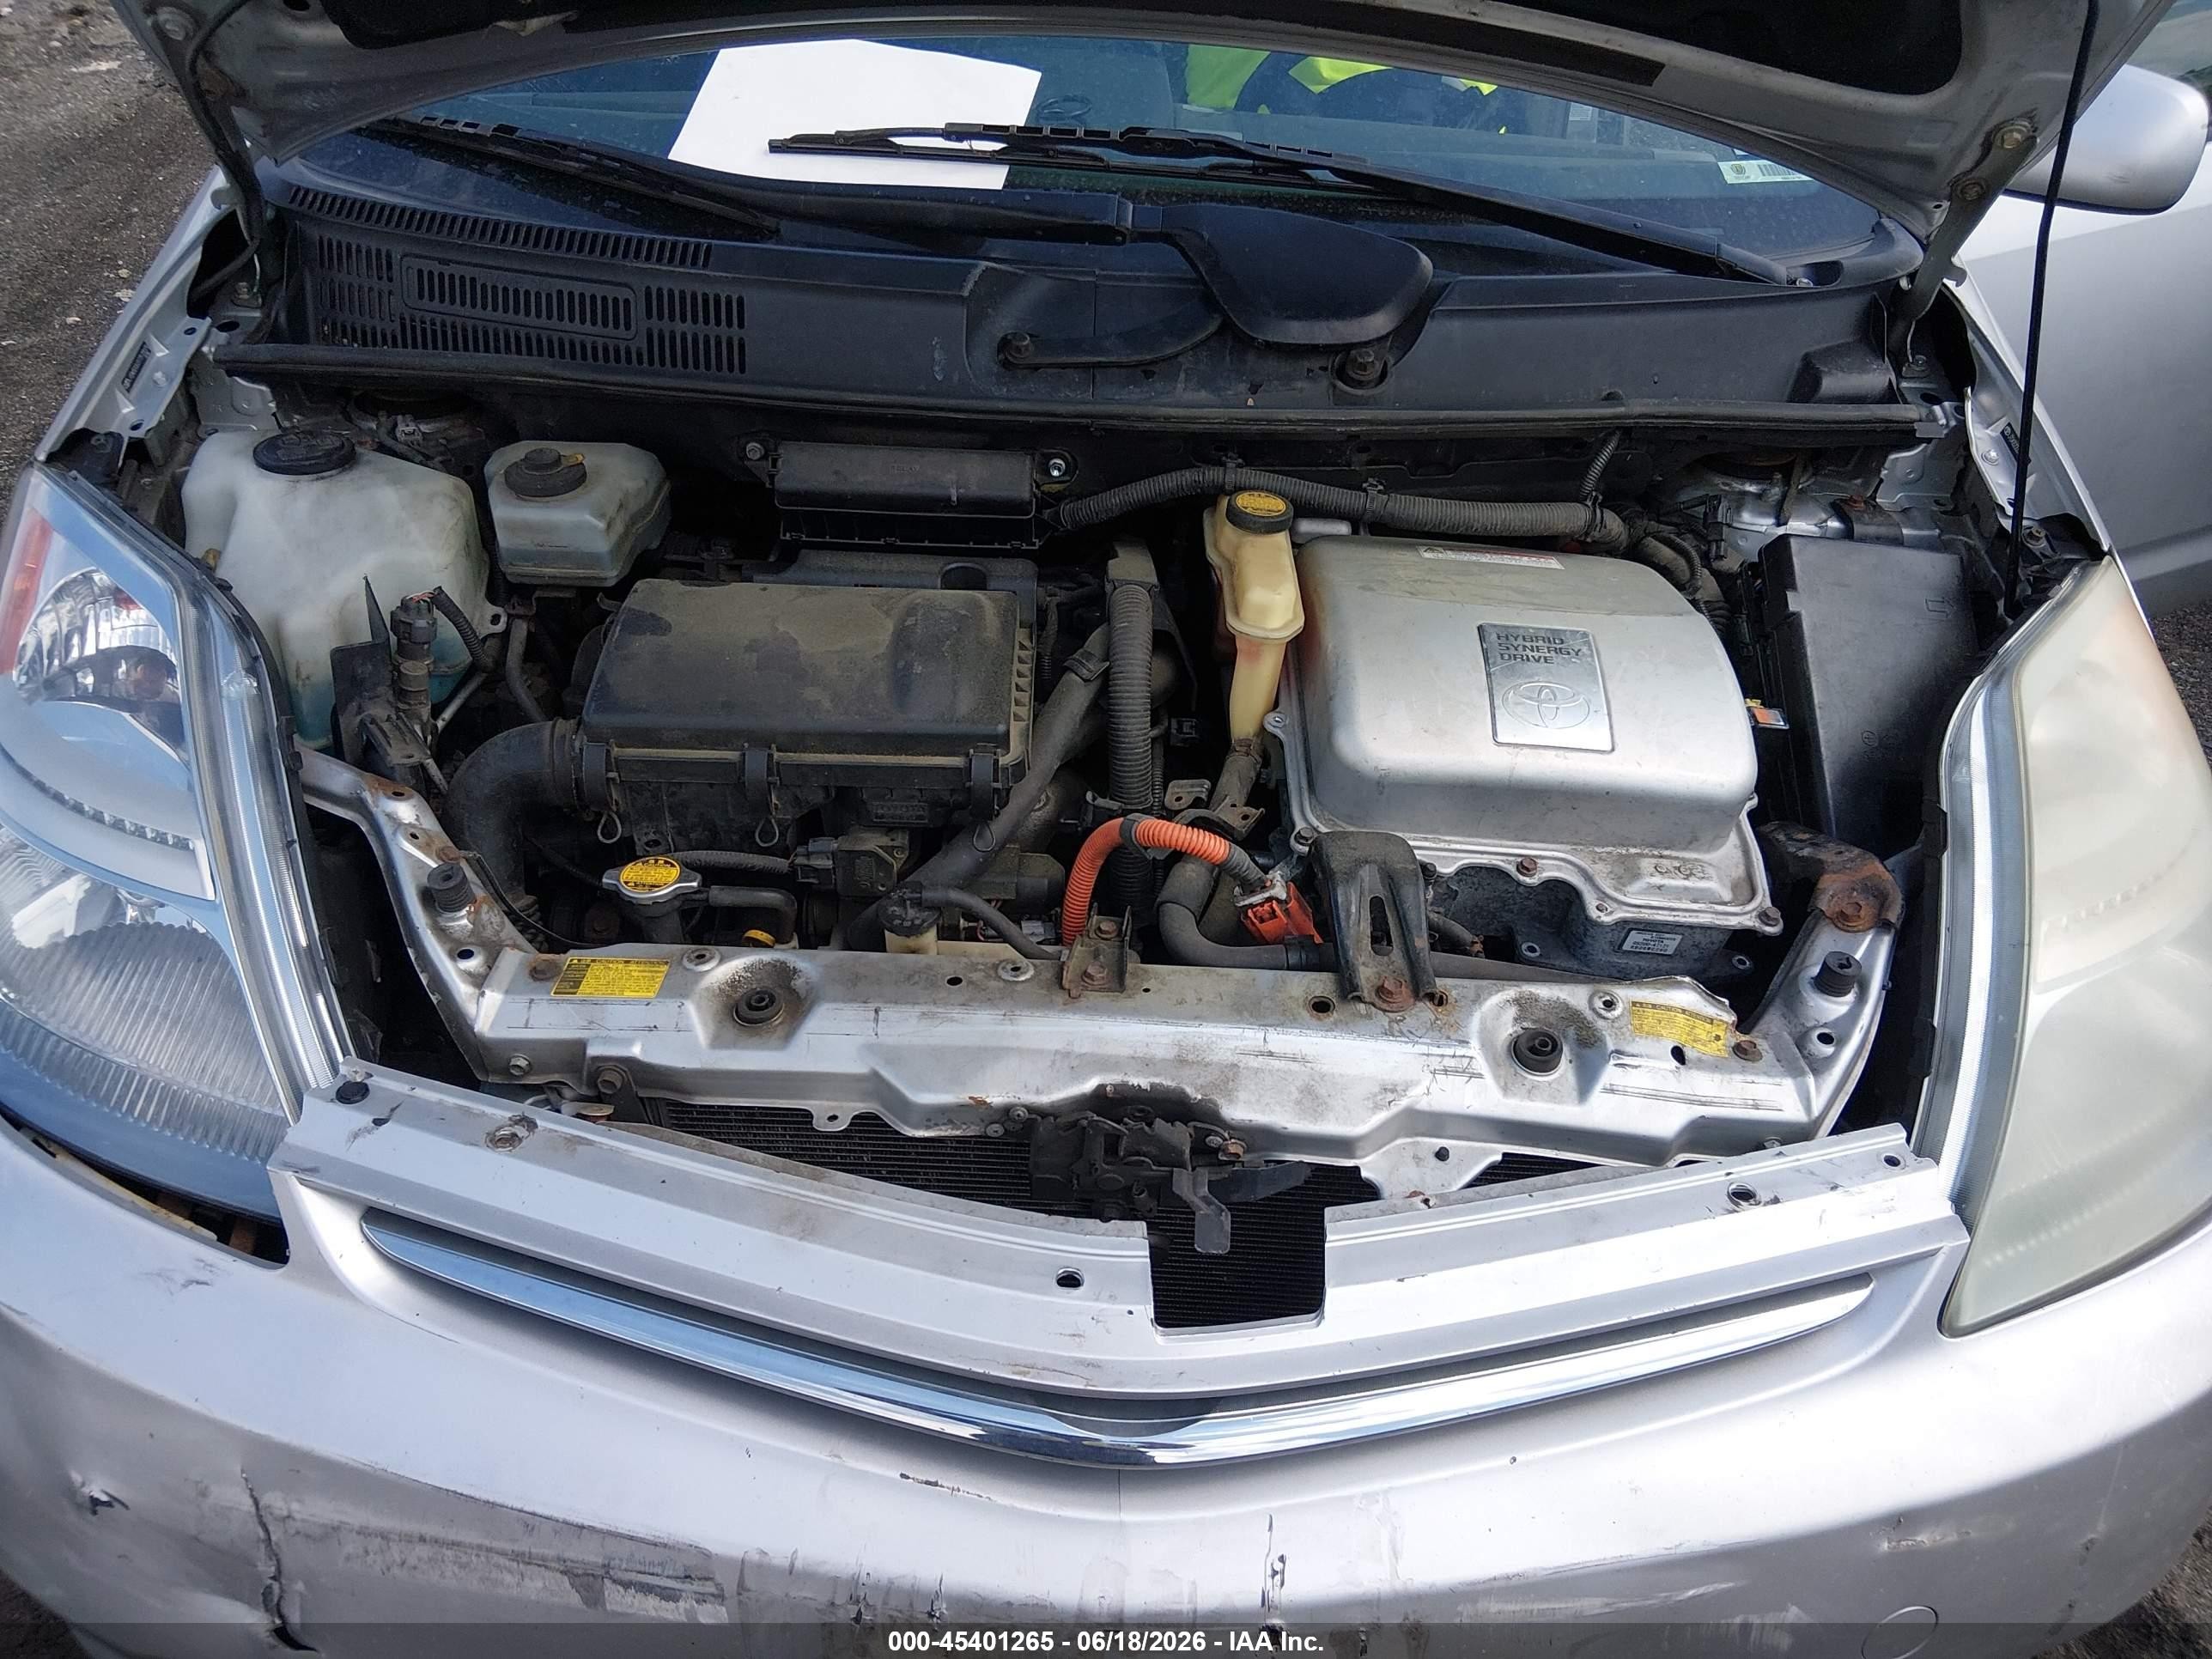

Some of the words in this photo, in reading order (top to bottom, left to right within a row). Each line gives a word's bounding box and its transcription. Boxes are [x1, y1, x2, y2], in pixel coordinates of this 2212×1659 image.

[1497, 633, 1564, 645] HYBRID
[1498, 643, 1582, 656] SYNERGY
[1499, 653, 1554, 664] DRIVE
